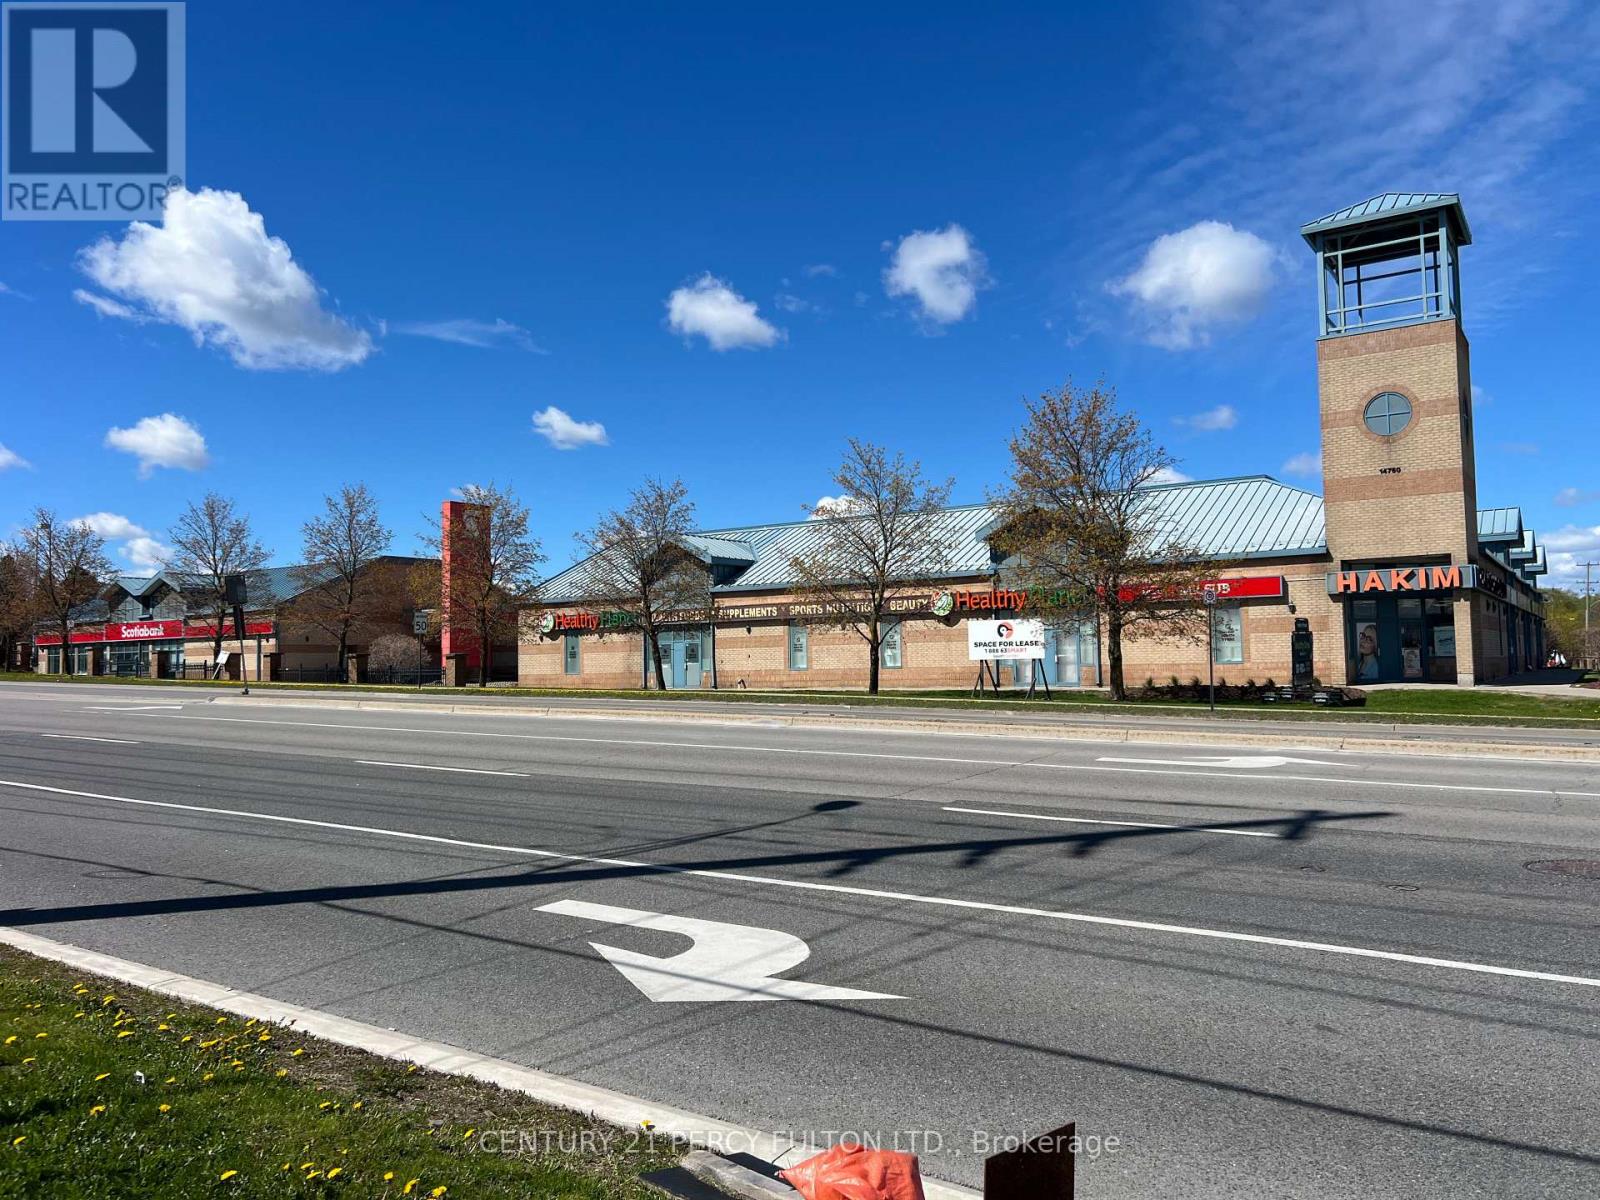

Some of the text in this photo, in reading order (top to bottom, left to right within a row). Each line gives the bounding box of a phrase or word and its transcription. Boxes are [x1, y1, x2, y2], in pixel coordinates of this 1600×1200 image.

[1336, 566, 1460, 593] HAKIM
[719, 606, 778, 618] SUPPLEMENTS
[789, 604, 822, 615] SPORTS
[890, 599, 928, 610] BEAUTY
[956, 589, 1026, 612] Healthy
[416, 621, 427, 631] 50
[555, 611, 598, 630] Healthy
[121, 624, 164, 638] Scotiabank
